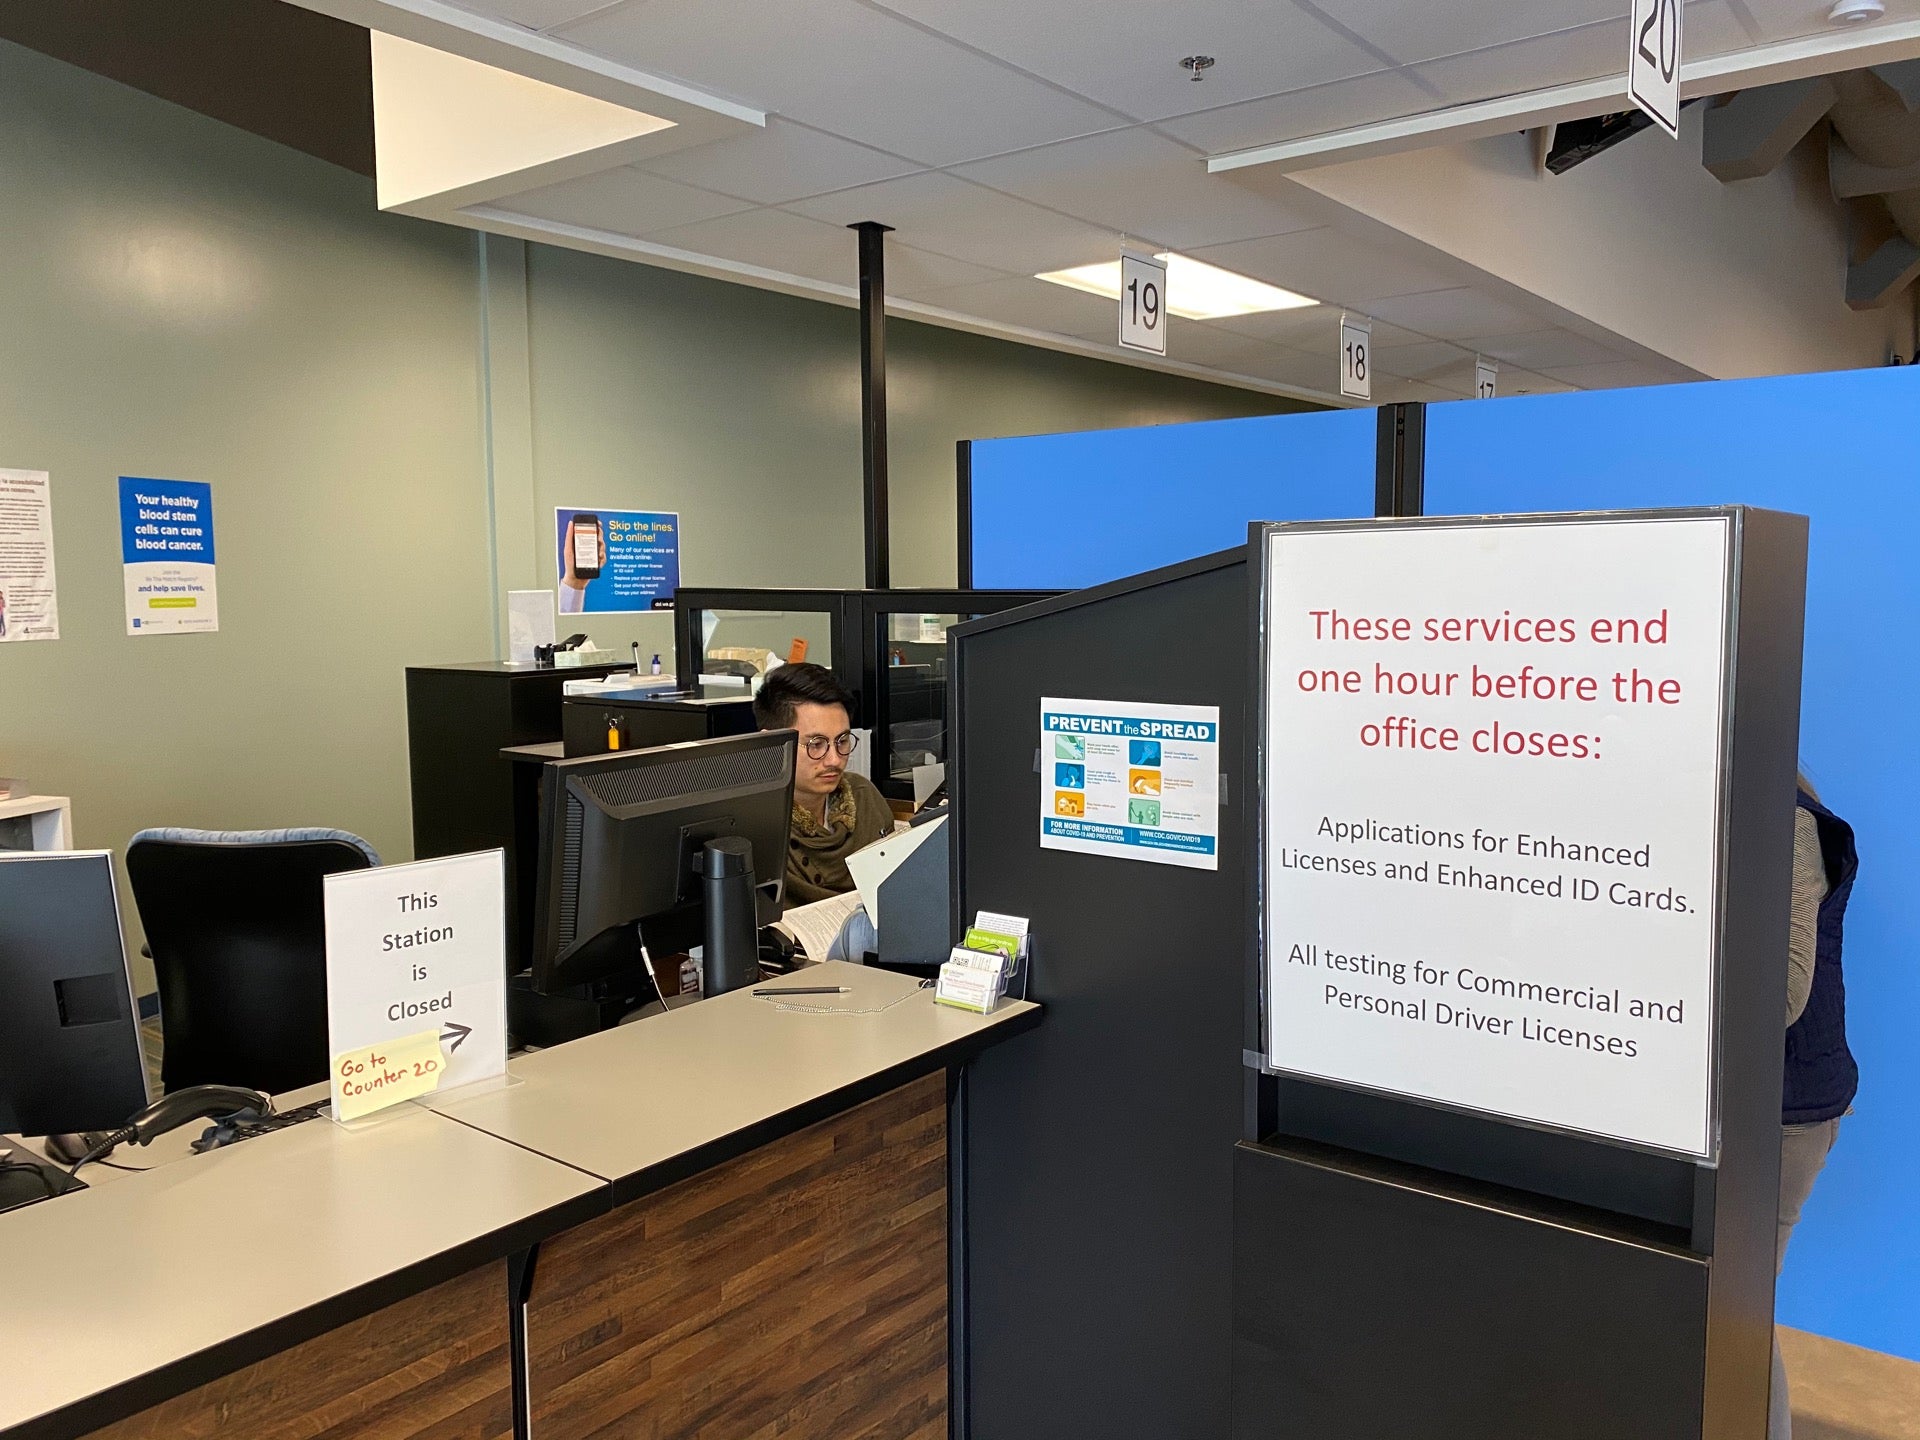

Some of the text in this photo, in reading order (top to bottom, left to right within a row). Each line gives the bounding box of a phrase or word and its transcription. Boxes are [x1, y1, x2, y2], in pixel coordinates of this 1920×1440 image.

[1638, 0, 1677, 84] 20
[1128, 278, 1159, 330] 19
[1346, 341, 1366, 381] 18
[1480, 380, 1494, 399] 17
[134, 493, 199, 510] Your healthy
[139, 508, 197, 522] blood stem
[609, 520, 675, 532] Skip the lines.
[135, 524, 203, 536] cells can cure
[609, 532, 656, 543] Go online!
[136, 538, 204, 551] blood cancer.
[609, 546, 625, 554] Many
[153, 584, 169, 593] help
[187, 584, 205, 592] lives.
[1309, 608, 1669, 644] These services end
[1297, 662, 1682, 704] one hour before the
[1049, 715, 1210, 740] PREVENT the SPREAD
[1359, 716, 1602, 759] office closes:
[1050, 820, 1124, 836] FOR MORE INFORMATION
[1050, 827, 1066, 835] ABOUT
[1317, 816, 1650, 868] Applications for Enhanced
[1281, 848, 1695, 914] Licenses and Enhanced ID Cards.
[398, 891, 438, 913] This
[382, 925, 454, 952] Station
[411, 964, 428, 981] is
[1288, 943, 1684, 1024] All testing for Commercial and
[387, 990, 452, 1022] Closed
[1325, 984, 1638, 1058] Personal Driver Licenses
[340, 1052, 387, 1077] Go to
[342, 1059, 438, 1097] Counter 20
